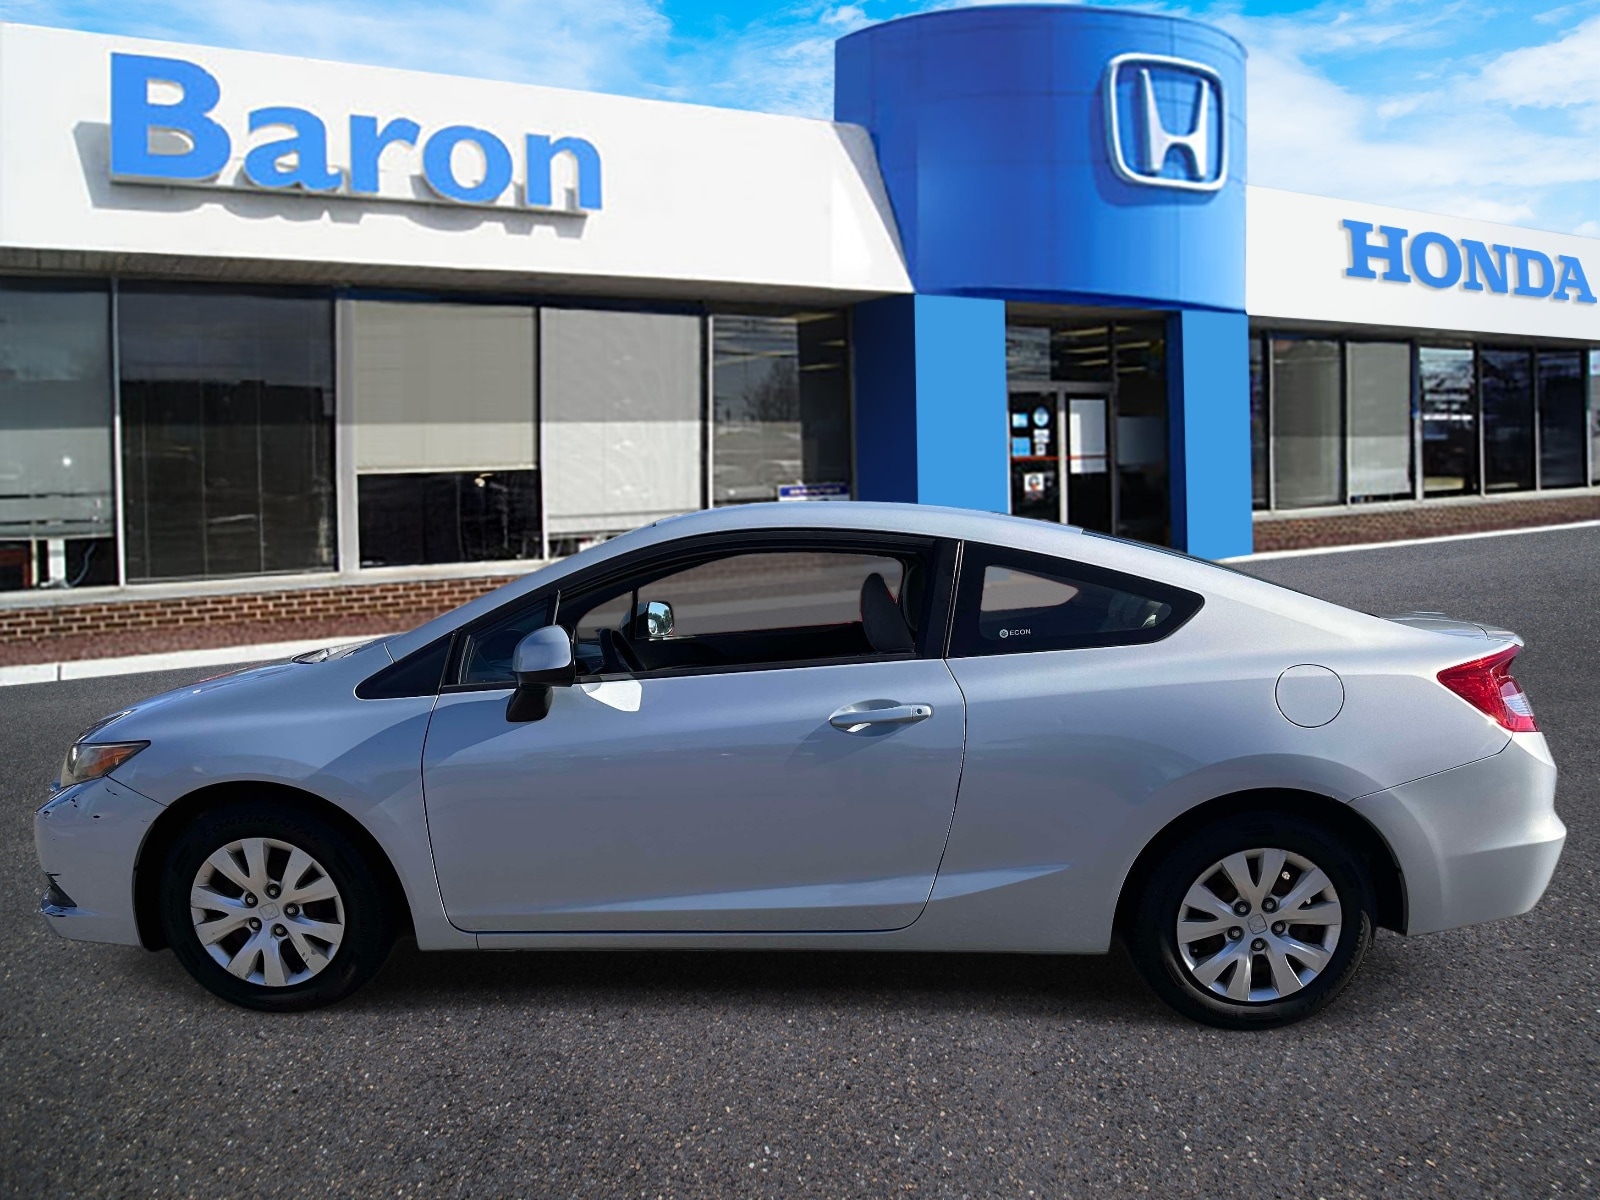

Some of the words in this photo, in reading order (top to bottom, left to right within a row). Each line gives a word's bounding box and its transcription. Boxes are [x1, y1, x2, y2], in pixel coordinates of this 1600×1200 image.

[110, 51, 603, 211] Baron
[1342, 218, 1598, 304] HONDA
[1009, 628, 1031, 636] ECON
